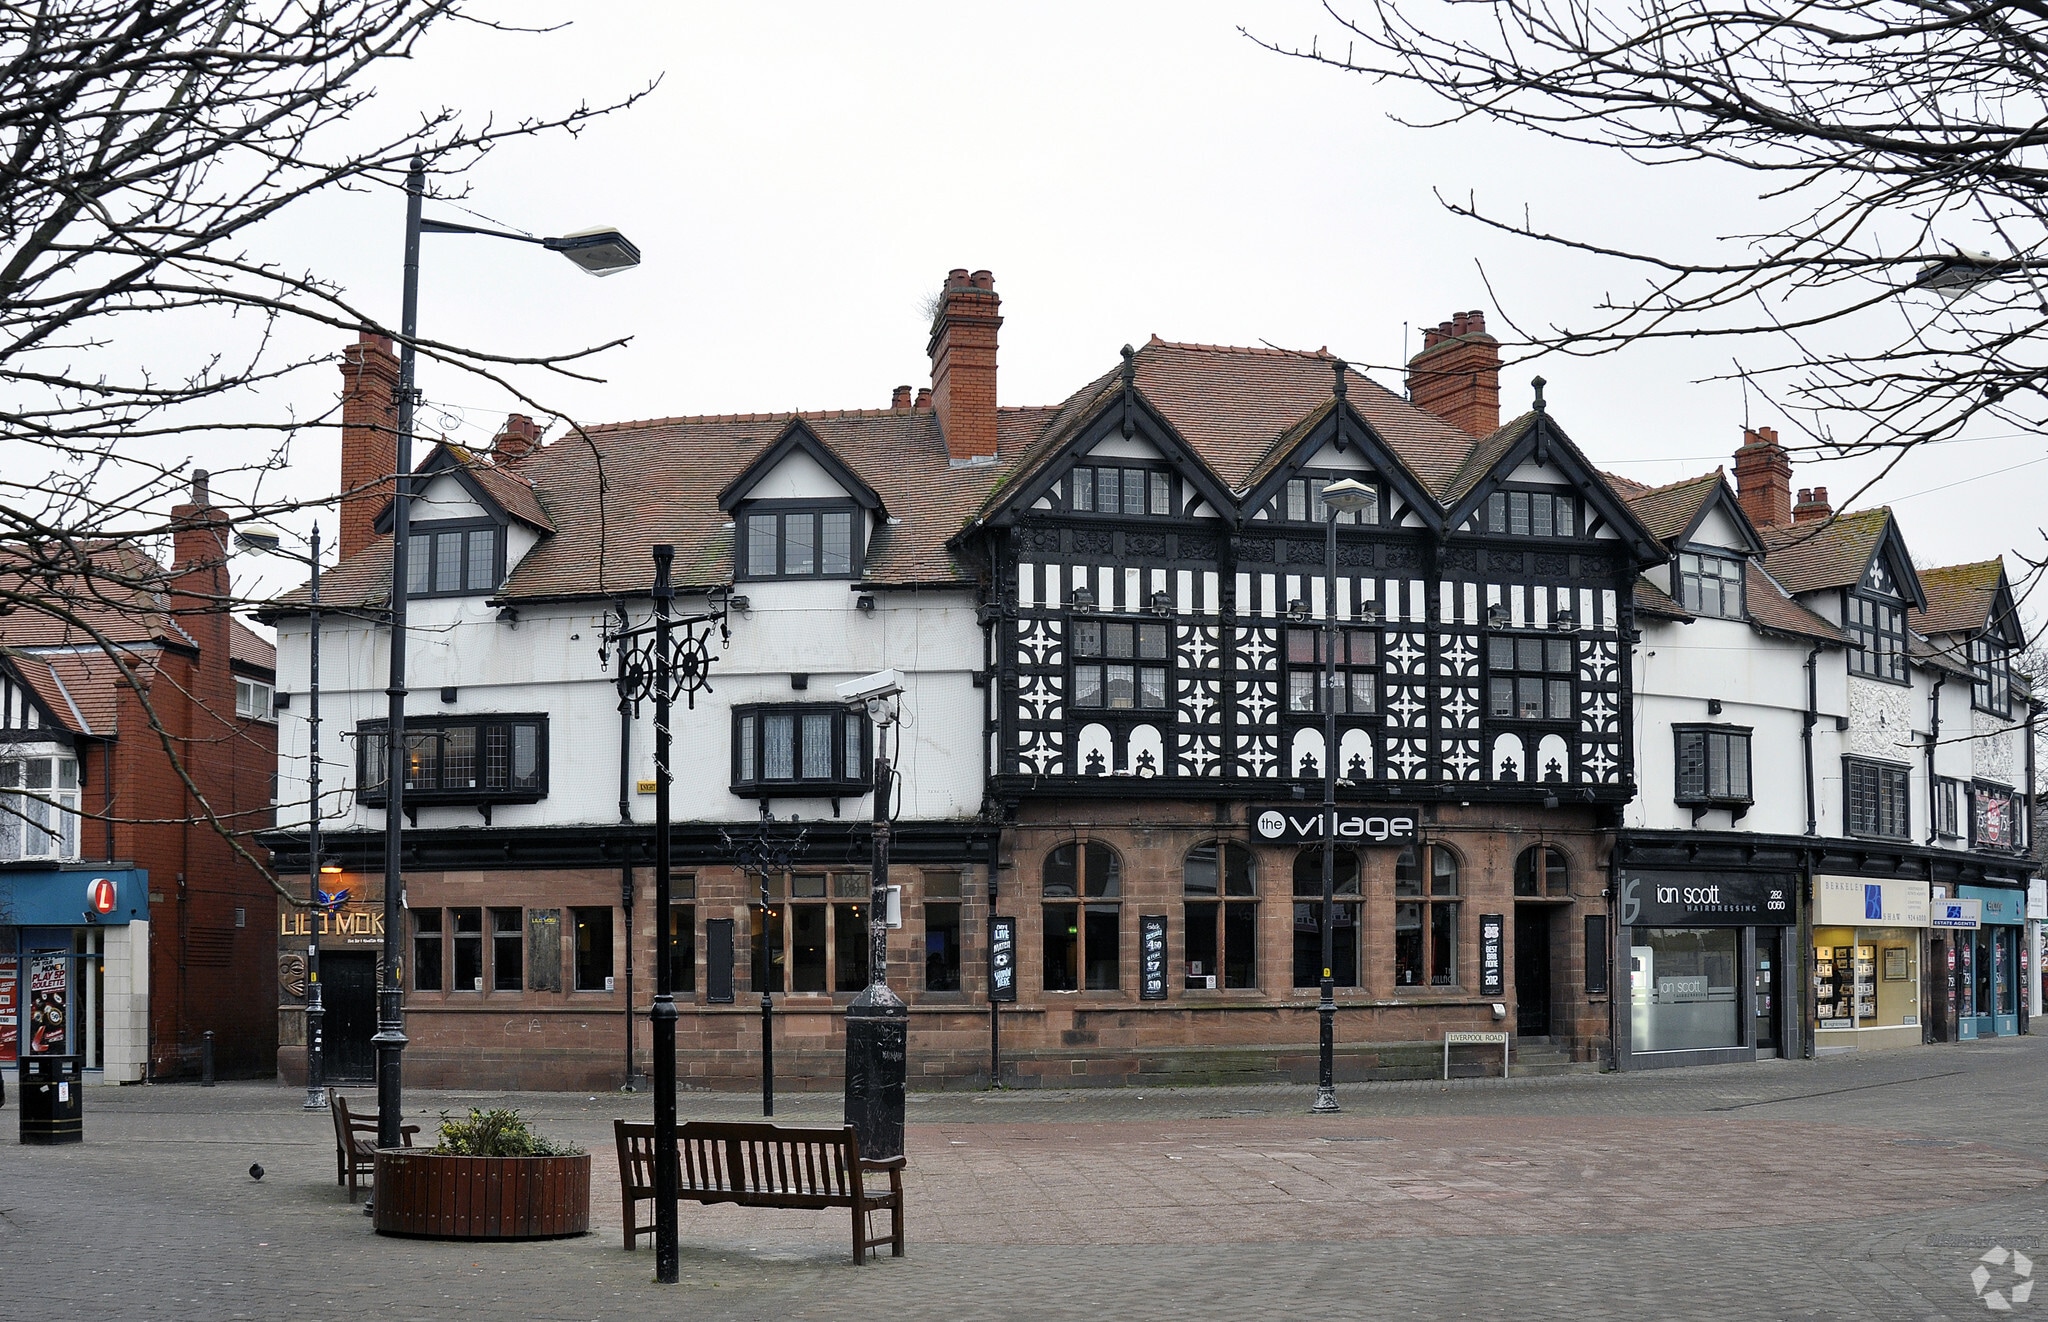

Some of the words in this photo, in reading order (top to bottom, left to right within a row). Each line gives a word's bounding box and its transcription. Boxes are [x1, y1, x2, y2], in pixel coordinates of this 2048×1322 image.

[1261, 817, 1283, 830] the
[1289, 812, 1413, 841] vilage.
[1825, 881, 1864, 891] BERKELEY
[99, 883, 110, 908] L
[1657, 884, 1679, 904] ian
[1683, 885, 1720, 904] scott
[1770, 890, 1782, 899] 282
[1767, 901, 1785, 910] 0060
[335, 913, 385, 935] MOK
[994, 929, 1010, 939] LIVE
[32, 971, 53, 982] PLAY
[54, 969, 65, 979] 5P
[1485, 975, 1499, 985] 2012
[32, 980, 65, 989] ROULETTE
[1147, 980, 1162, 990] £10
[1677, 980, 1701, 993] scott
